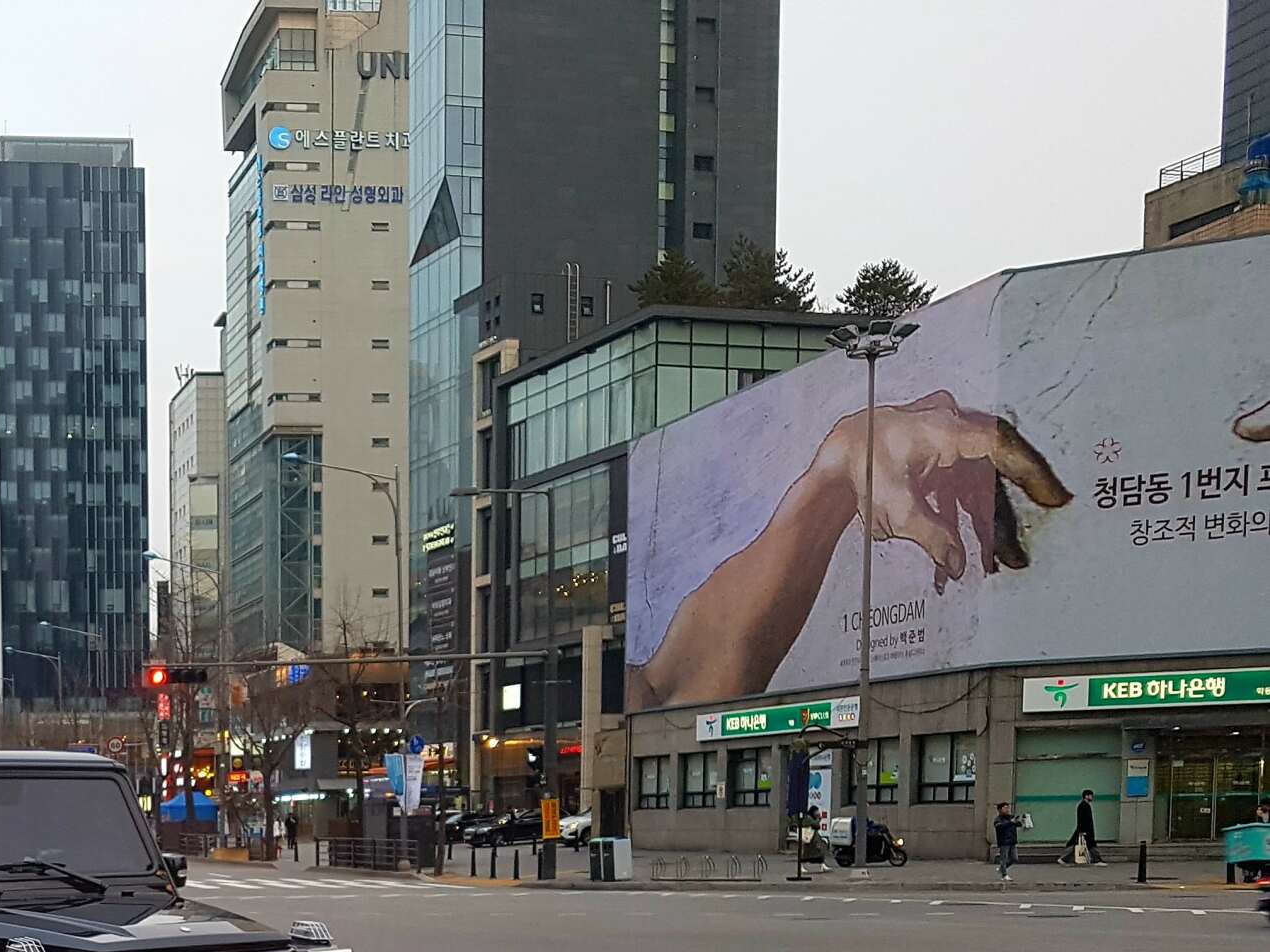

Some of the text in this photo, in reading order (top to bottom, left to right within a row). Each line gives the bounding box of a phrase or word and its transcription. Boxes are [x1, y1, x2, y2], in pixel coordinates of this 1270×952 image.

[295, 129, 380, 150] 에스플란트
[352, 185, 403, 204] 성형외과
[1092, 472, 1173, 509] 청담동
[1181, 464, 1249, 500] 1번지
[1130, 514, 1196, 546] 창조적
[857, 635, 888, 652] Dgned
[1102, 682, 1143, 699] KEB
[1146, 677, 1226, 699] 하나은행
[726, 716, 739, 731] KEB
[740, 714, 767, 731] 하나은행
